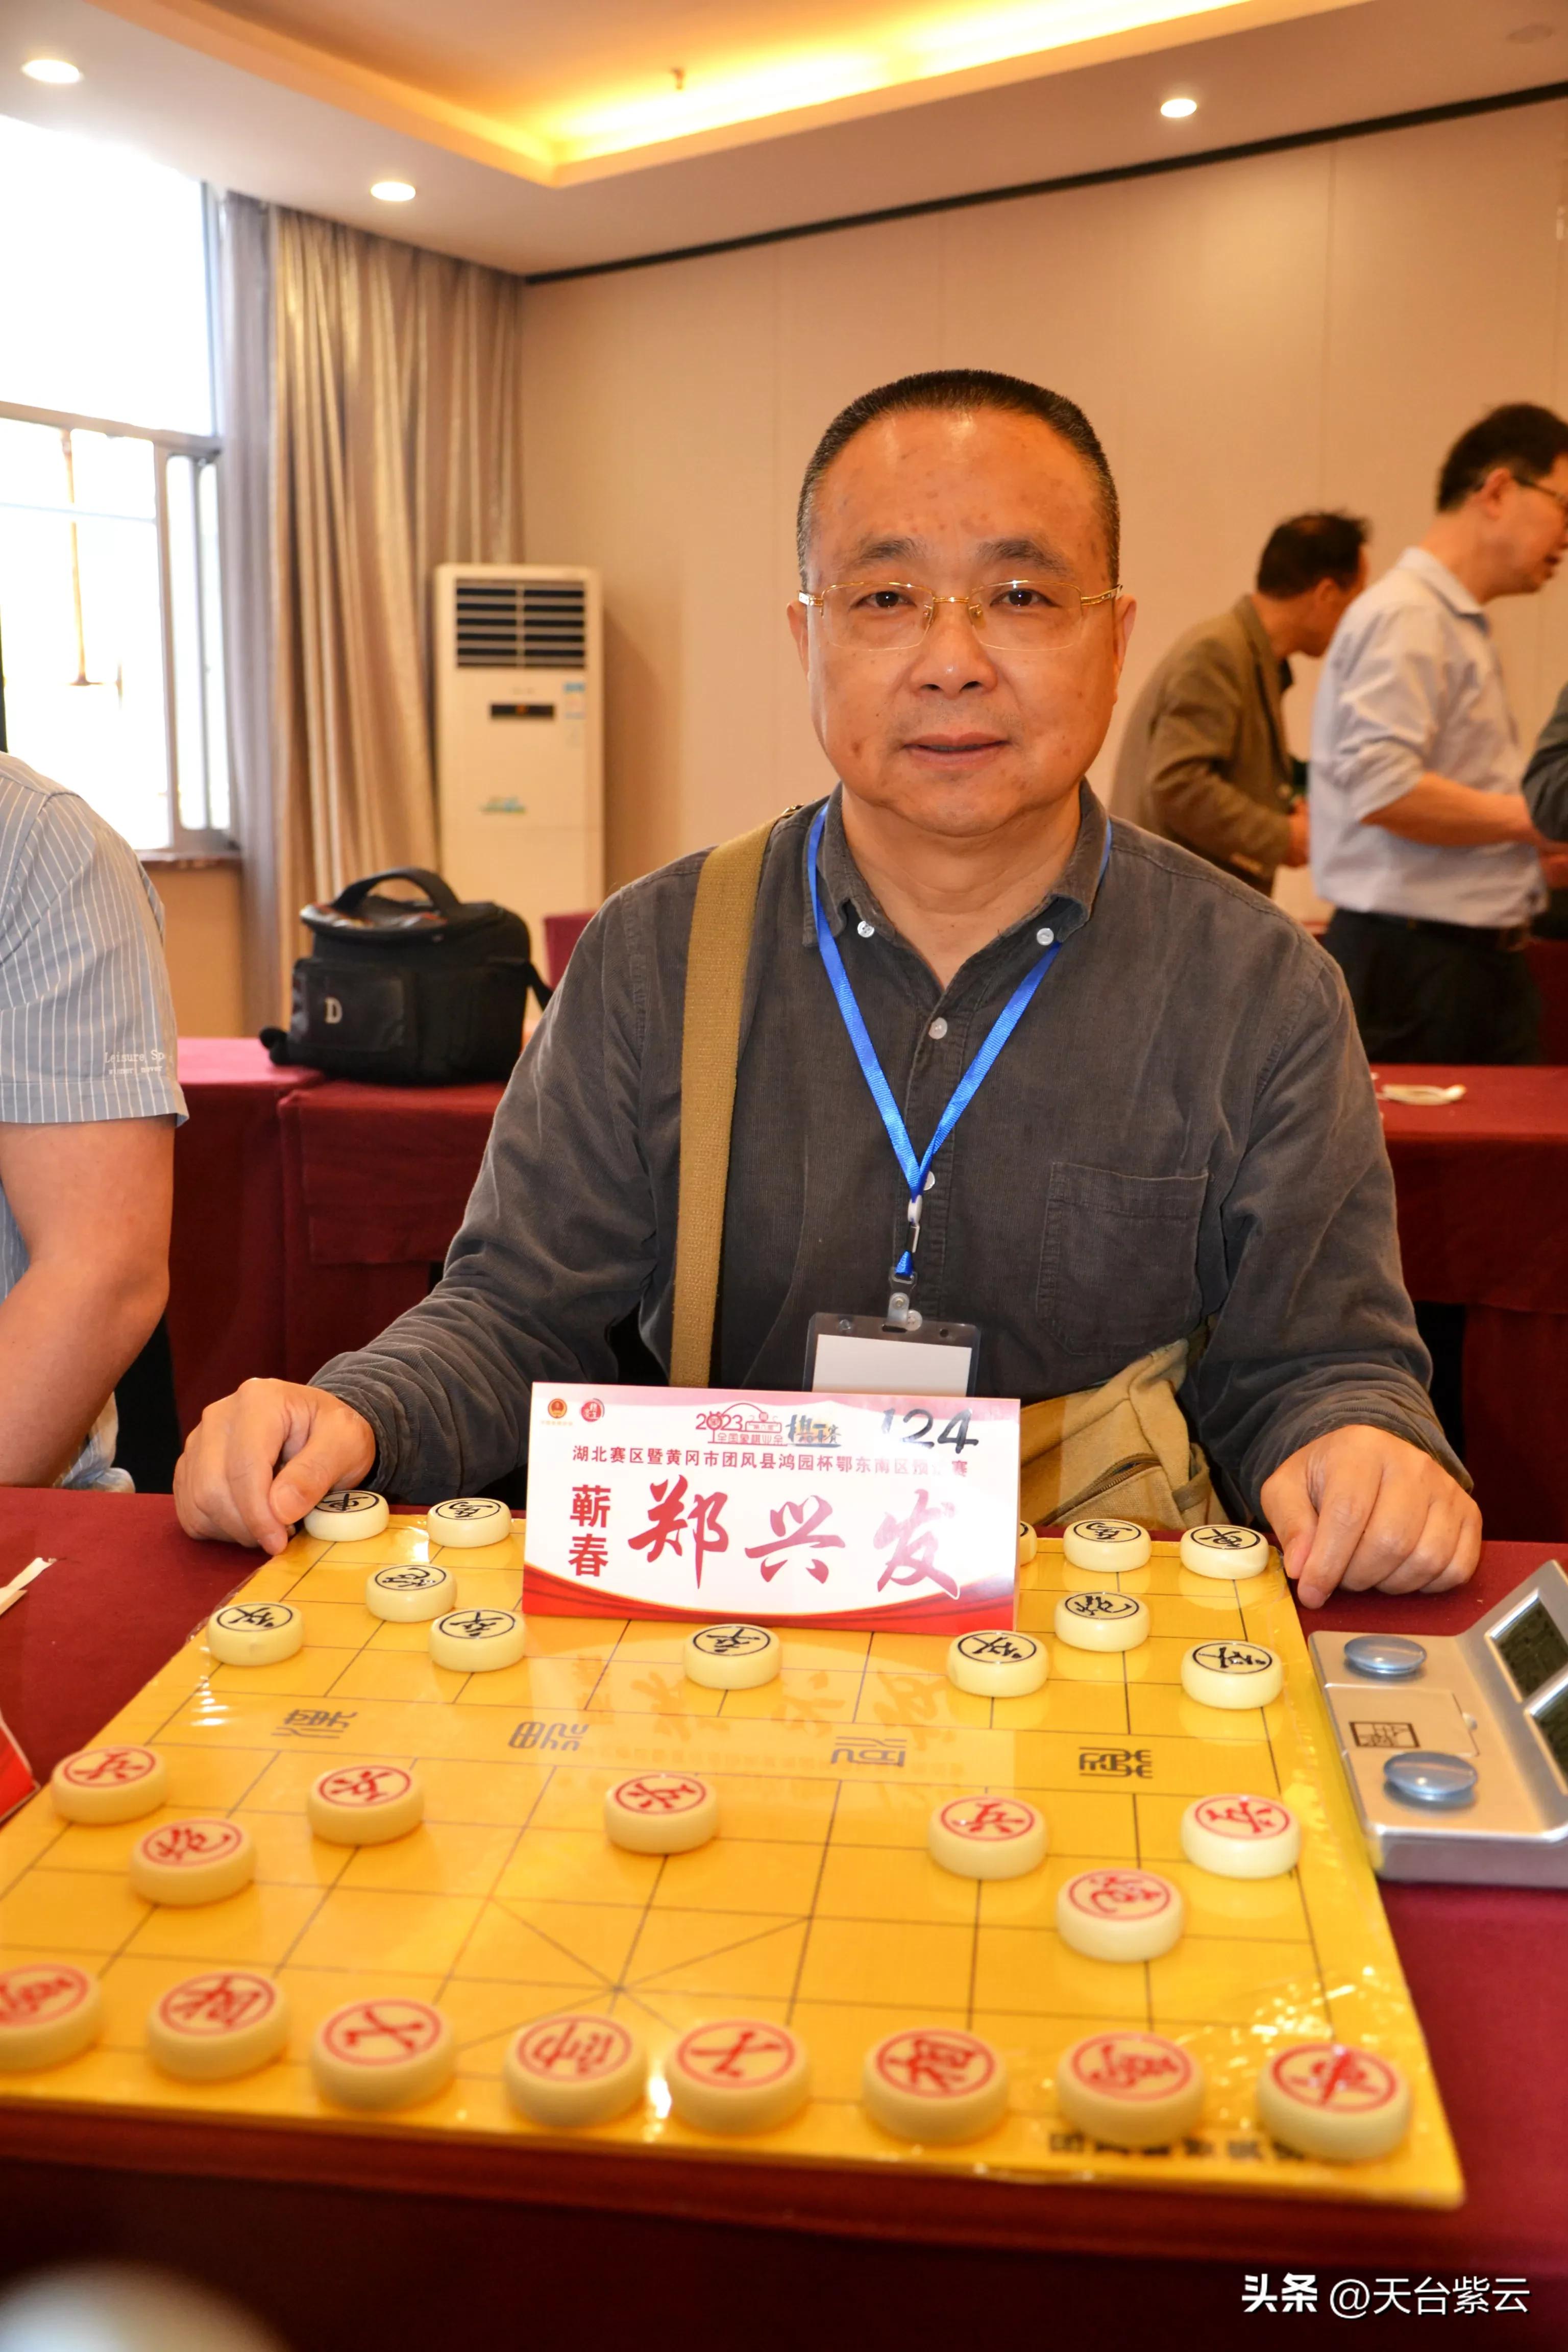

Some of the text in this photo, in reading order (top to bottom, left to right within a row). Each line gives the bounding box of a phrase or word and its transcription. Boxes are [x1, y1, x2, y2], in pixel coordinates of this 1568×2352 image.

[104, 1051, 144, 1063] Leisure
[881, 1408, 979, 1454] 124
[573, 1445, 968, 1477] 湖北赛区暨黄冈市团风县鸿园杯鄂东南区预赛
[568, 1484, 611, 1577] 蕲春
[627, 1474, 961, 1600] 郑兴发
